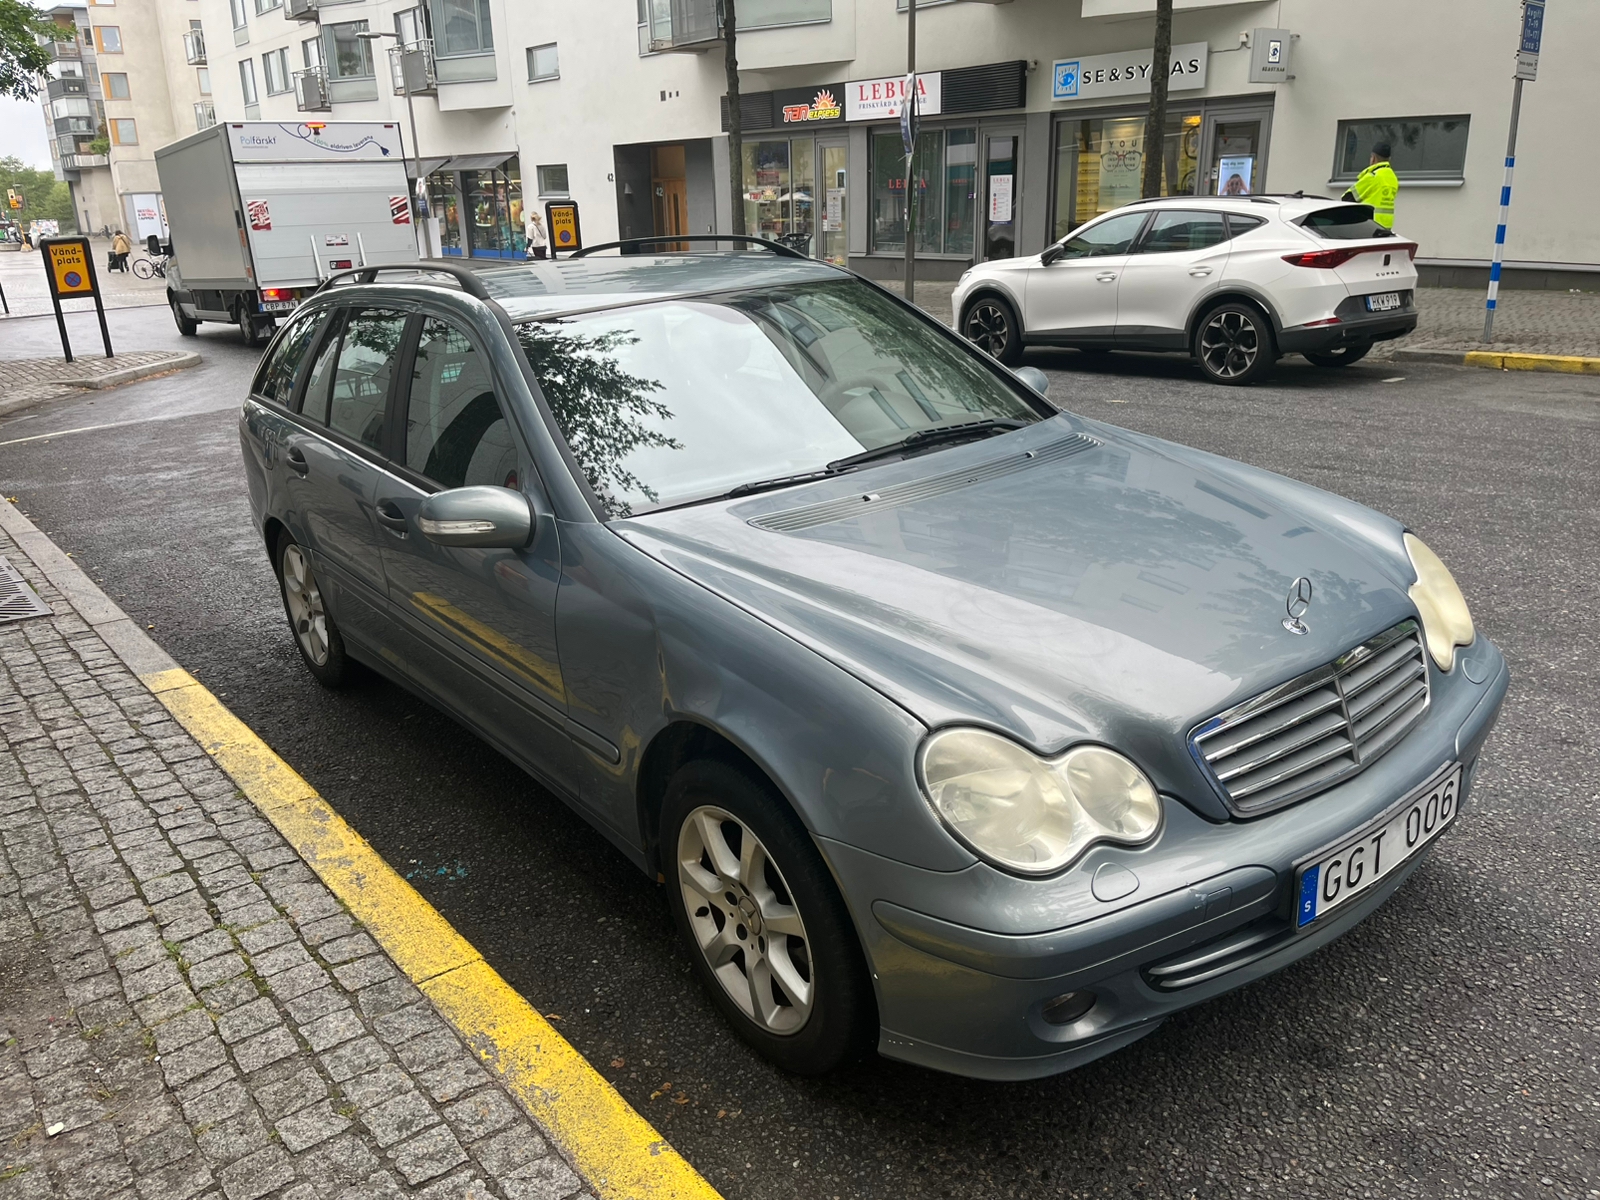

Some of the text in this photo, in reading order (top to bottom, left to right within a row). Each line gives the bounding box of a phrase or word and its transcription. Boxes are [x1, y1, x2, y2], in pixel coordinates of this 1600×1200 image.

[1527, 7, 1542, 19] Avgift
[1522, 39, 1539, 50] Taxa 3
[1083, 59, 1200, 84] SE&SYAS
[859, 99, 892, 109] FRISKVÅRD
[809, 107, 840, 119] express
[241, 136, 276, 145] Polfärskt
[1109, 140, 1137, 148] YOU
[607, 173, 614, 182] 42
[888, 178, 926, 189] LEA
[656, 187, 664, 197] 42
[51, 247, 82, 256] Vänd-
[57, 257, 81, 266] plats
[265, 301, 296, 310] CBP 87N
[1323, 780, 1454, 903] GGT 006
[1304, 900, 1311, 913] S
